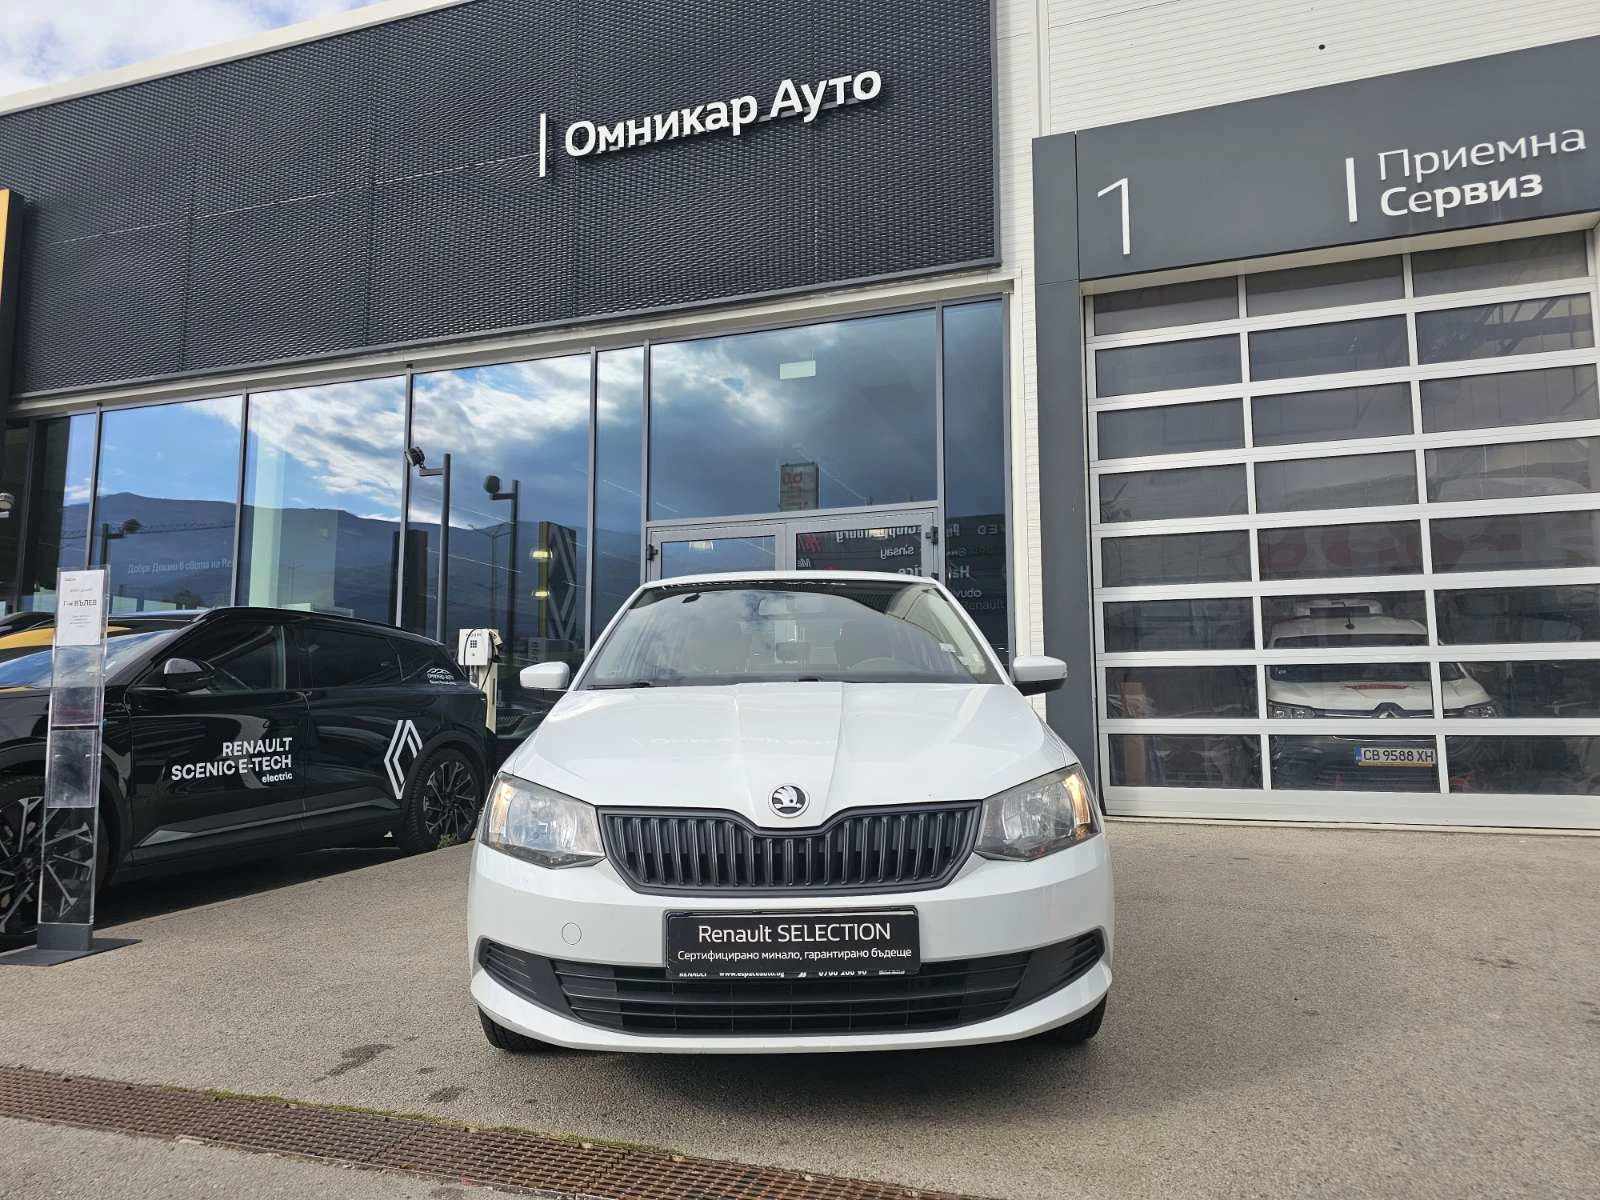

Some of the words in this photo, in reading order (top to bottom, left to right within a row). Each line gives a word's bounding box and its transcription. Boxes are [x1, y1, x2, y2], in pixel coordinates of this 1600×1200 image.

[564, 94, 758, 157] Омникар
[770, 70, 882, 123] Ауто
[1378, 128, 1587, 184] Приемна
[1379, 172, 1544, 218] Сервиз
[1097, 177, 1131, 255] 1
[222, 737, 293, 756] RENAULT
[1363, 749, 1380, 761] CB
[1383, 750, 1414, 762] 9588
[1416, 750, 1434, 762] XH
[171, 760, 236, 781] SCENIC
[238, 754, 292, 774] E-TECH
[261, 771, 293, 783] electric
[698, 925, 772, 943] Renault
[777, 922, 892, 942] SELECTION
[677, 950, 759, 961] Сертифицирано
[761, 950, 802, 961] минало,
[804, 949, 869, 960] гарантирано
[871, 947, 912, 958] бъдеще
